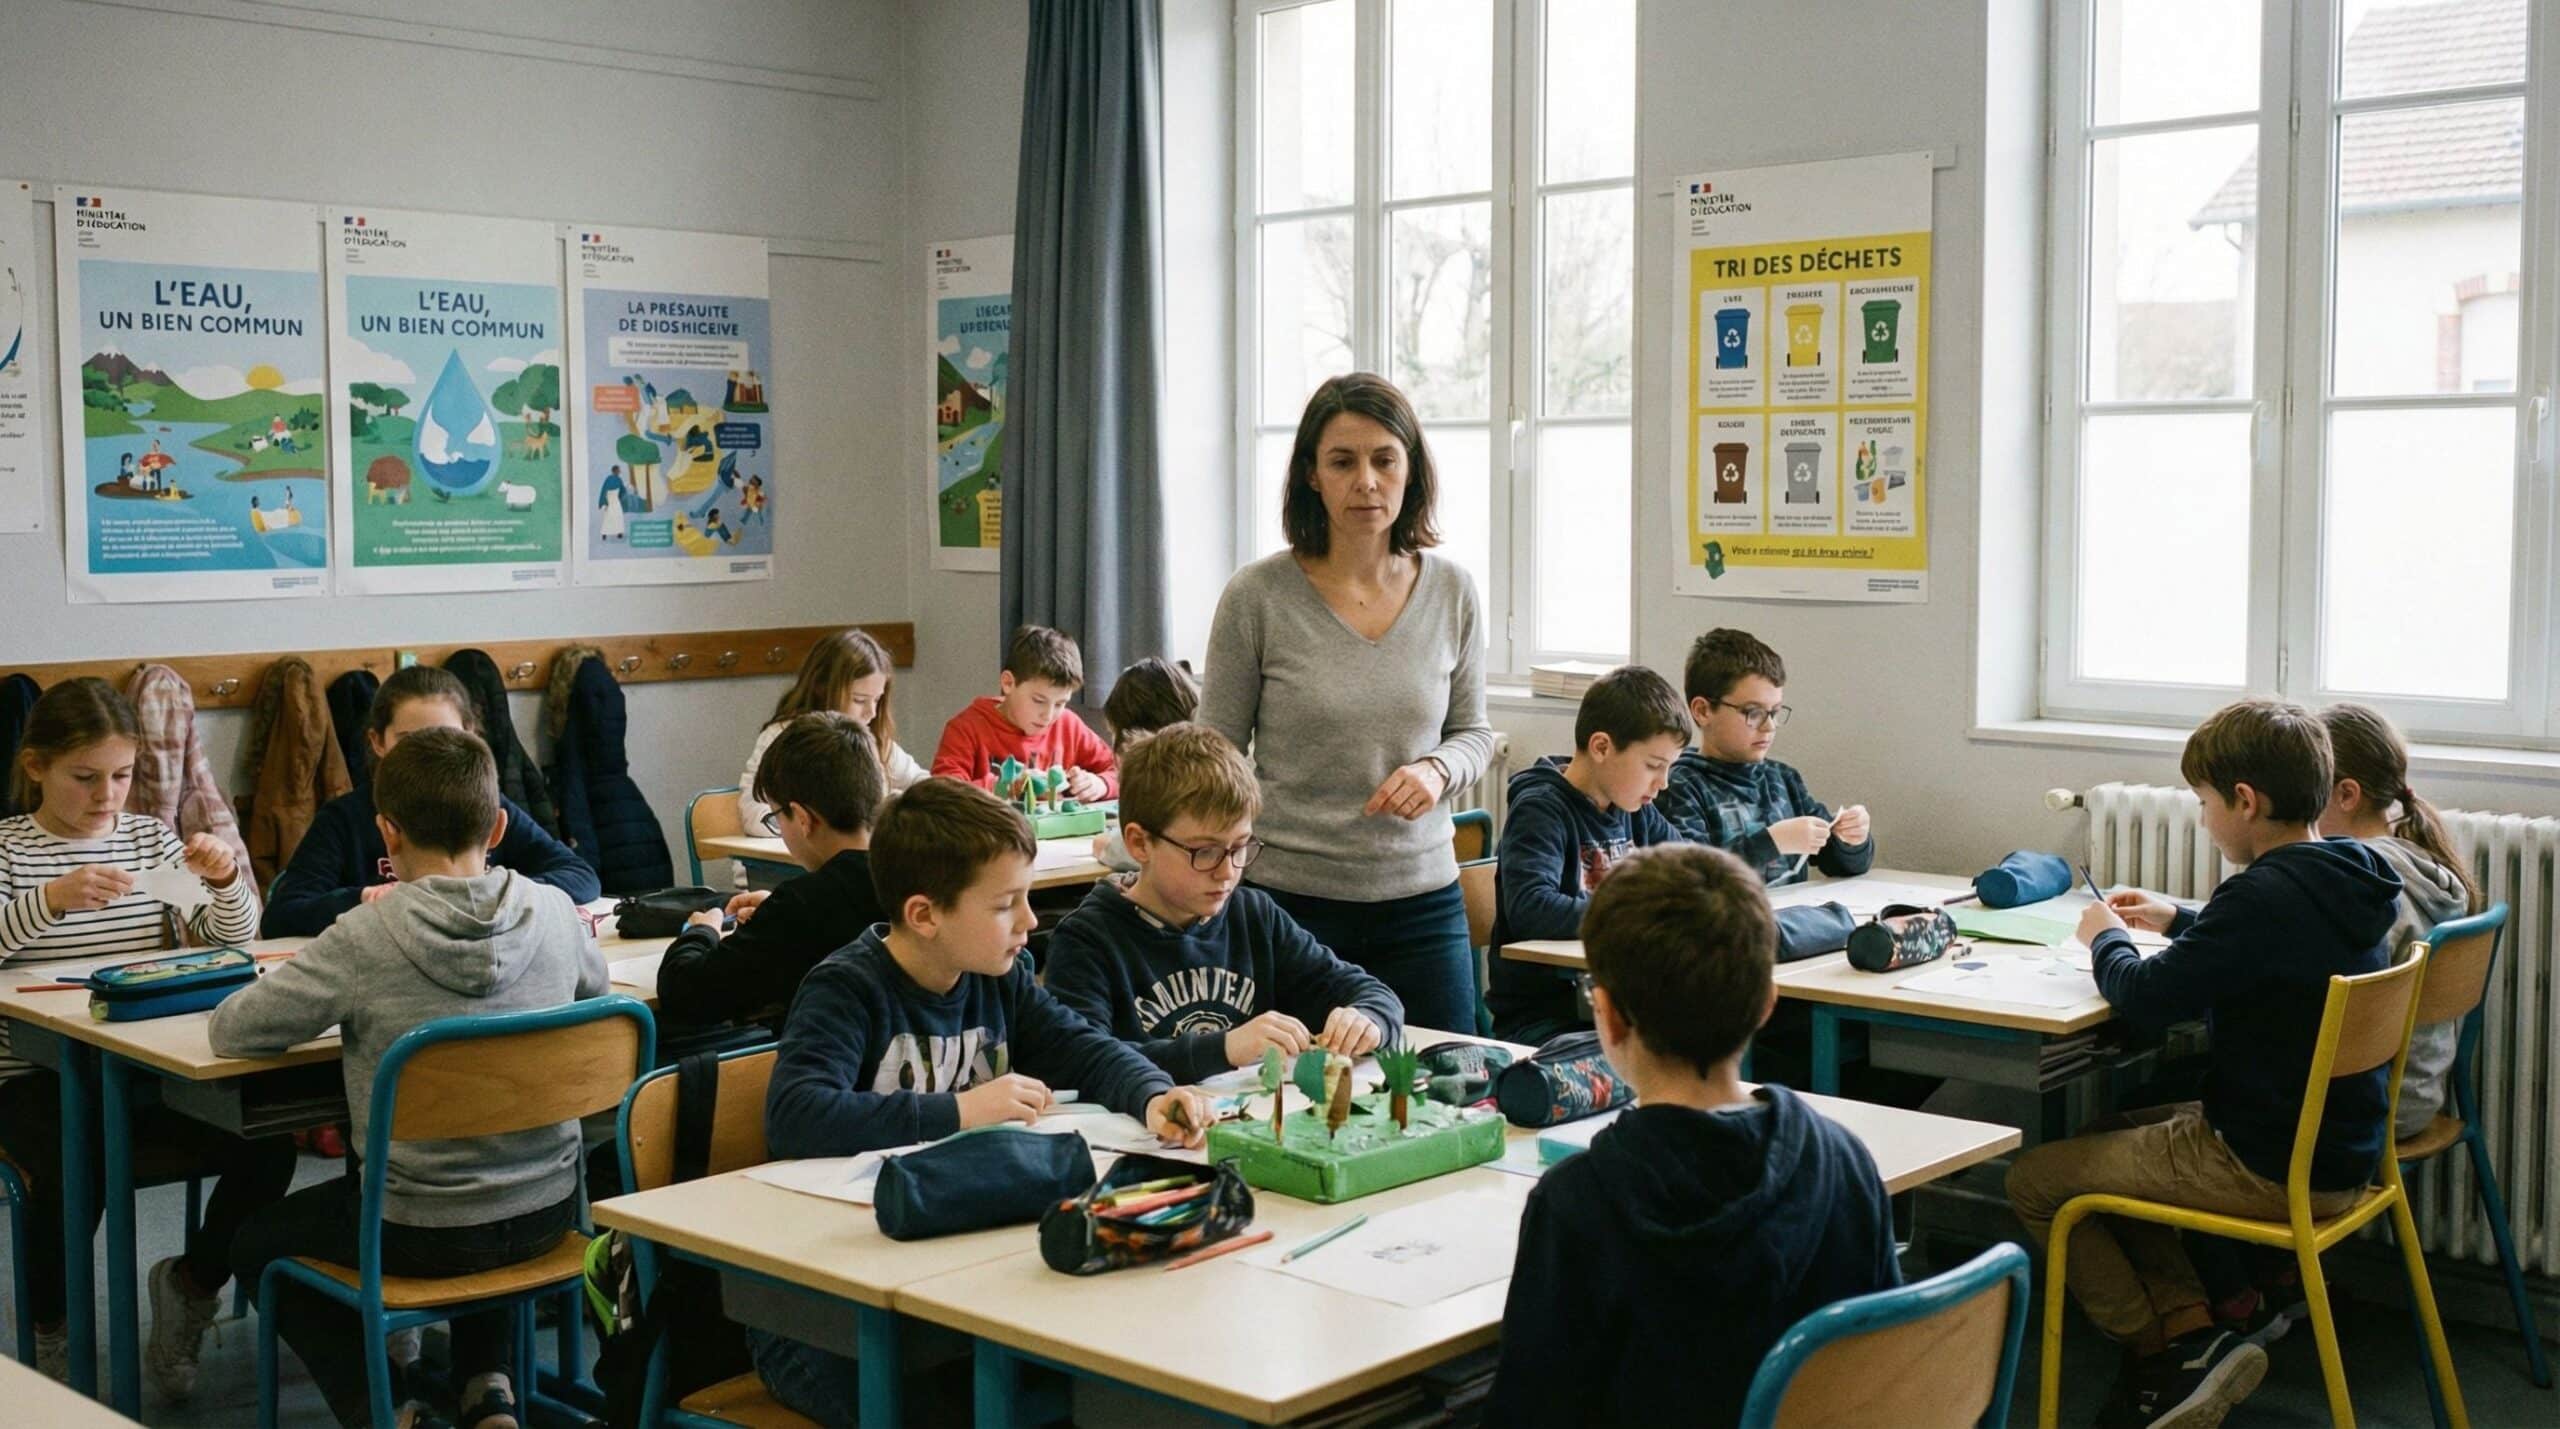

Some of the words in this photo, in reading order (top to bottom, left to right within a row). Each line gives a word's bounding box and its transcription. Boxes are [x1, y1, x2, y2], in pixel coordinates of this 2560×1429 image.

[1714, 258, 1746, 279] TRI
[1753, 254, 1793, 276] DES
[1800, 247, 1902, 273] DÉCHETS
[155, 280, 252, 314] L'EAU,
[419, 290, 491, 318] L'EAU,
[628, 301, 646, 315] LA
[100, 310, 133, 330] UN
[141, 312, 193, 332] BIEN
[200, 315, 303, 337] COMMUN
[361, 315, 391, 333] UN
[399, 316, 445, 335] BIEN
[451, 319, 545, 340] COMMUN
[619, 318, 639, 332] DE
